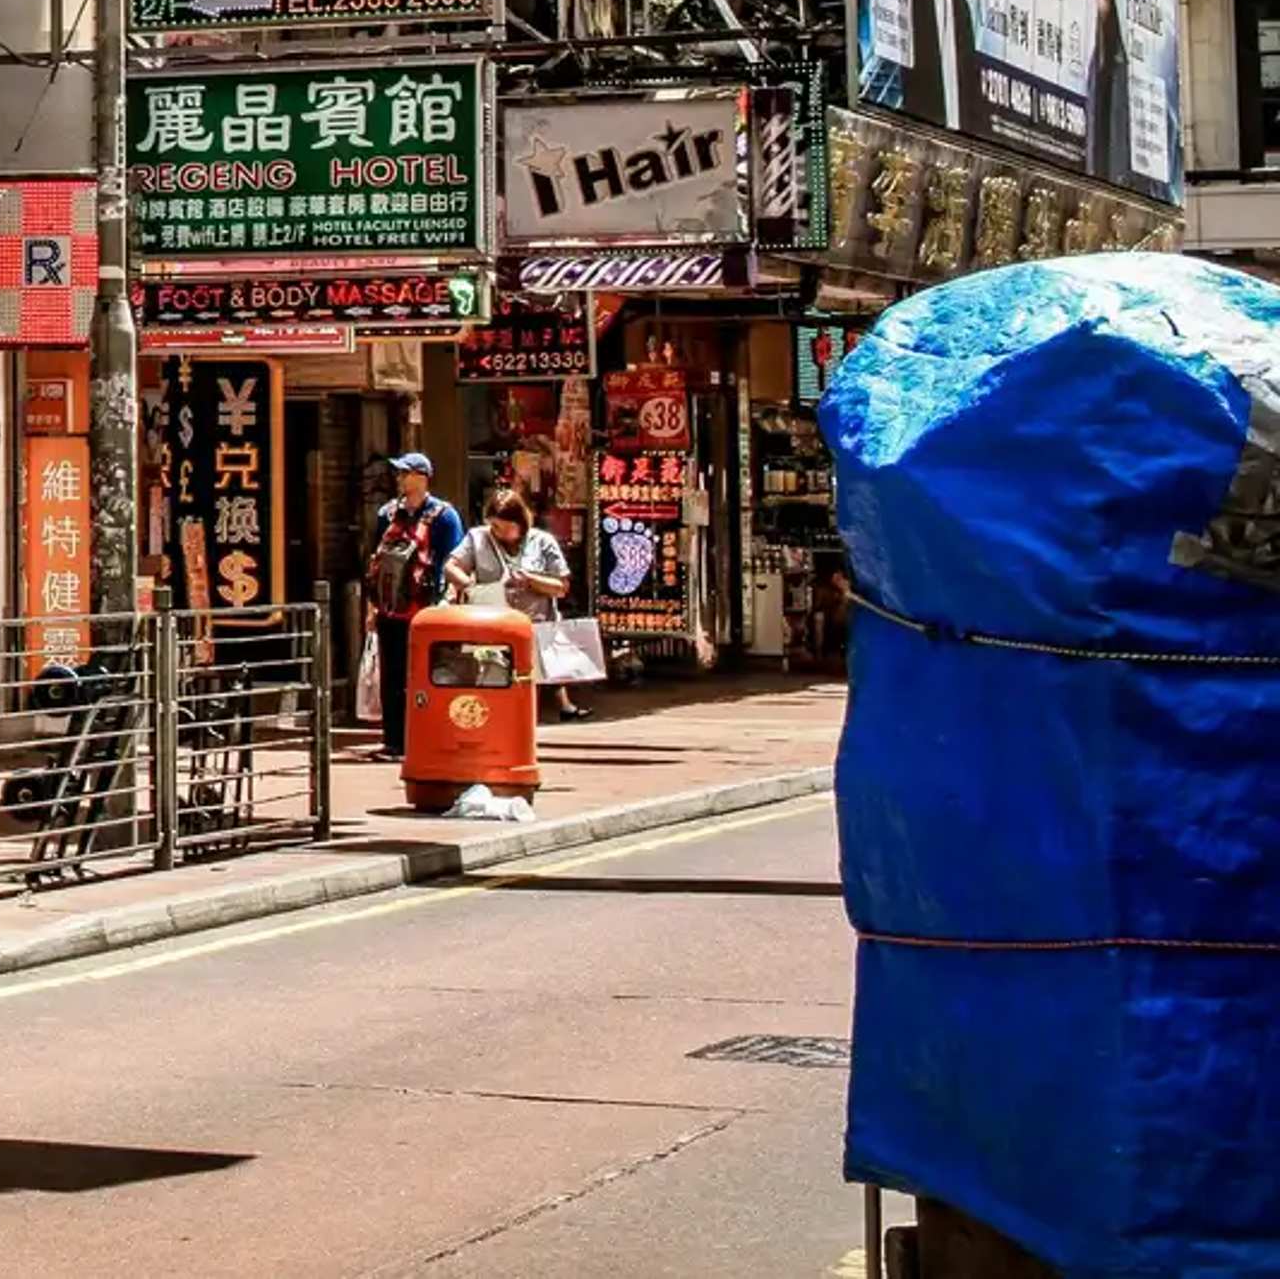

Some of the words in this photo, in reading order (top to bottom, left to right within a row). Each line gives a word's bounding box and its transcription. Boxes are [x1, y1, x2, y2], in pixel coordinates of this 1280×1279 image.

[136, 73, 463, 155] 麗晶賓館
[331, 153, 469, 188] HOTEL
[158, 288, 225, 311] FOOT
[230, 287, 245, 309] &
[251, 285, 321, 309] BODY
[326, 281, 450, 307] MASSAGE
